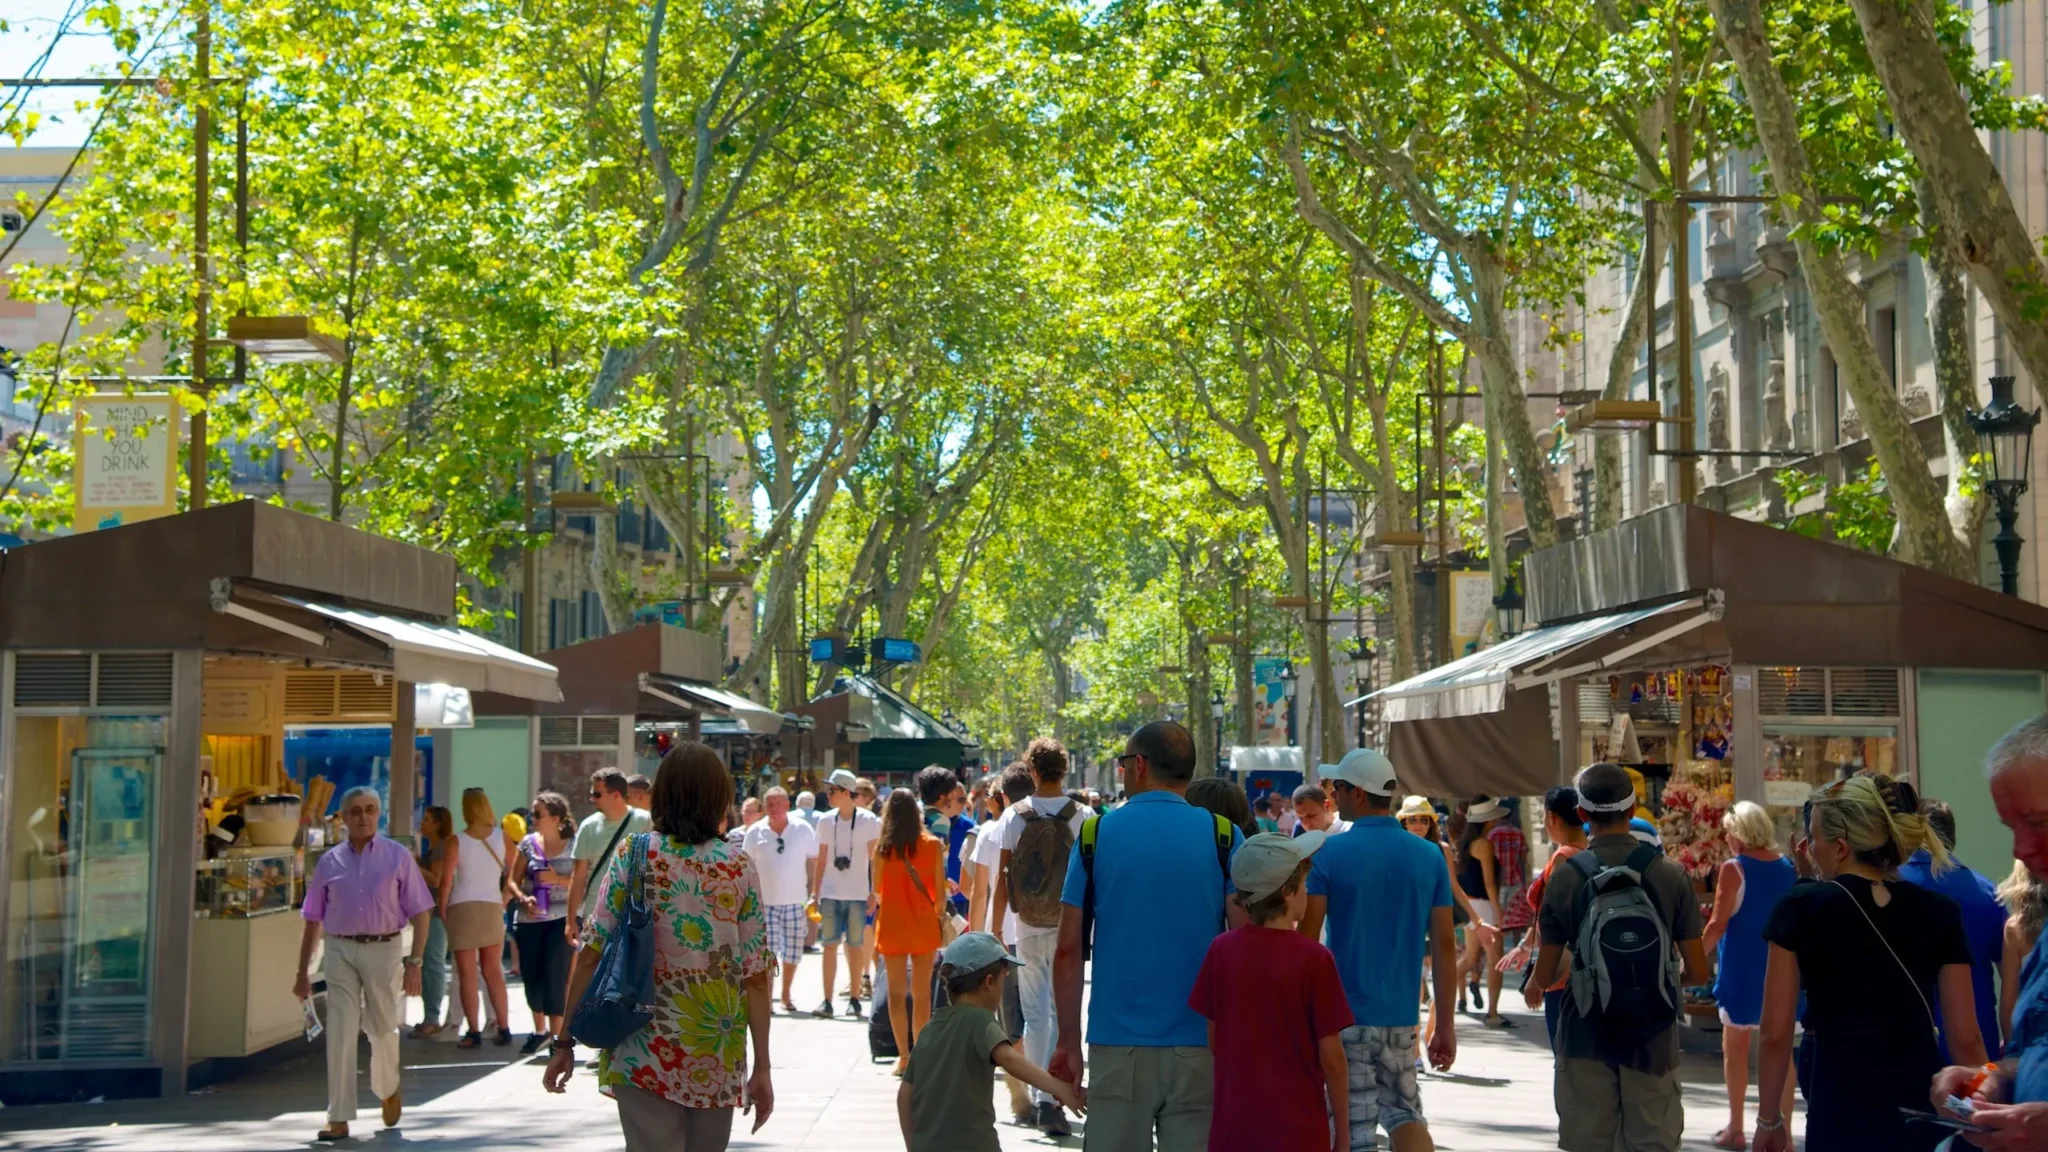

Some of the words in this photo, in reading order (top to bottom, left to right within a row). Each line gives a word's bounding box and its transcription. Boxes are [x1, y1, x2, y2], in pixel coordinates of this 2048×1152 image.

[107, 405, 148, 421] MIND
[110, 439, 142, 455] YOU
[102, 454, 151, 472] DRINK
